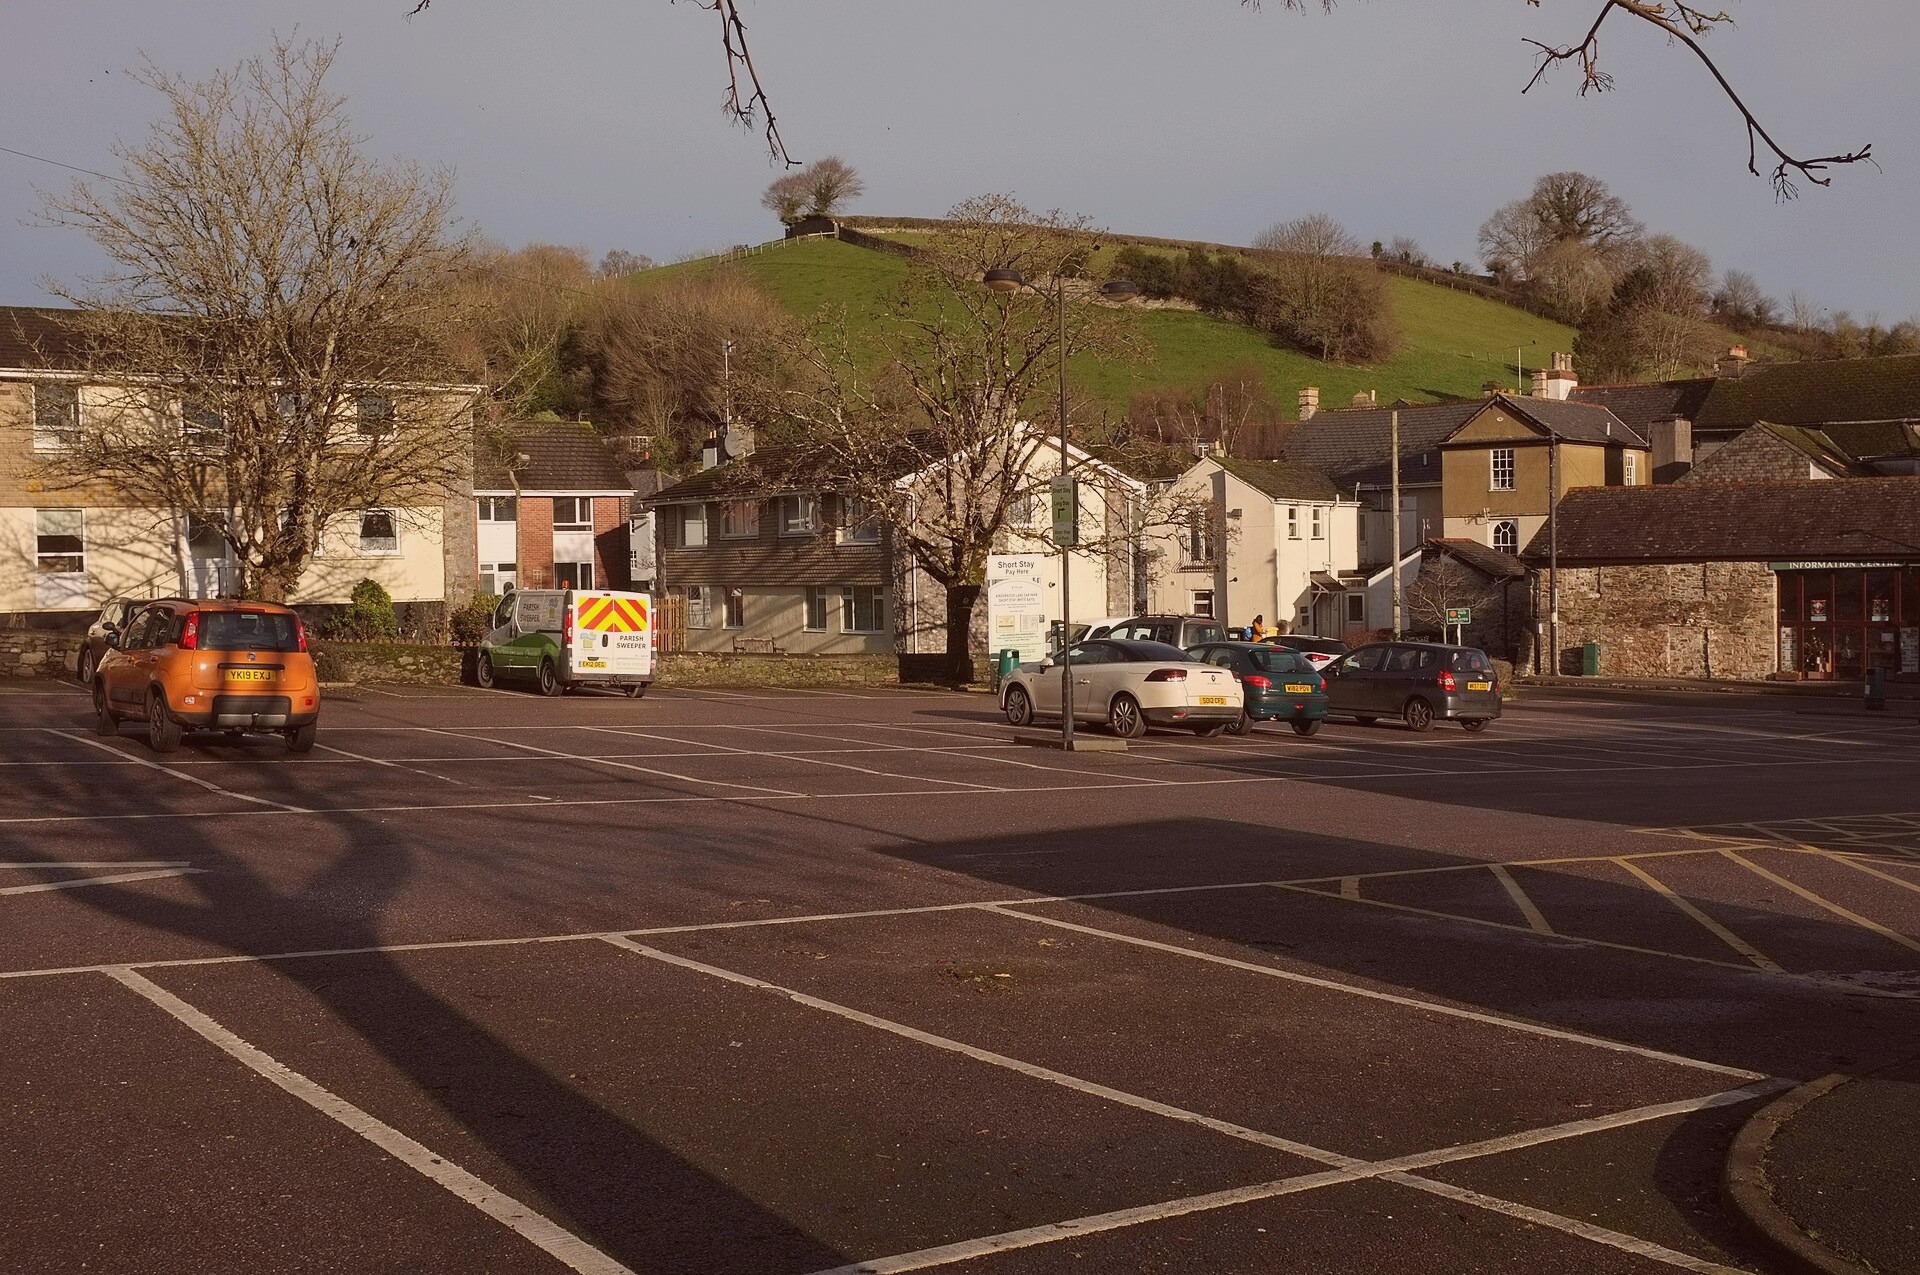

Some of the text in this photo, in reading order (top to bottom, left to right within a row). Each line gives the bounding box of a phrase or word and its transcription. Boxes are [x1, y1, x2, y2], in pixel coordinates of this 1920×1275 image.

[998, 561, 1034, 569] Short Stay
[231, 671, 271, 680] YK19 EXJ
